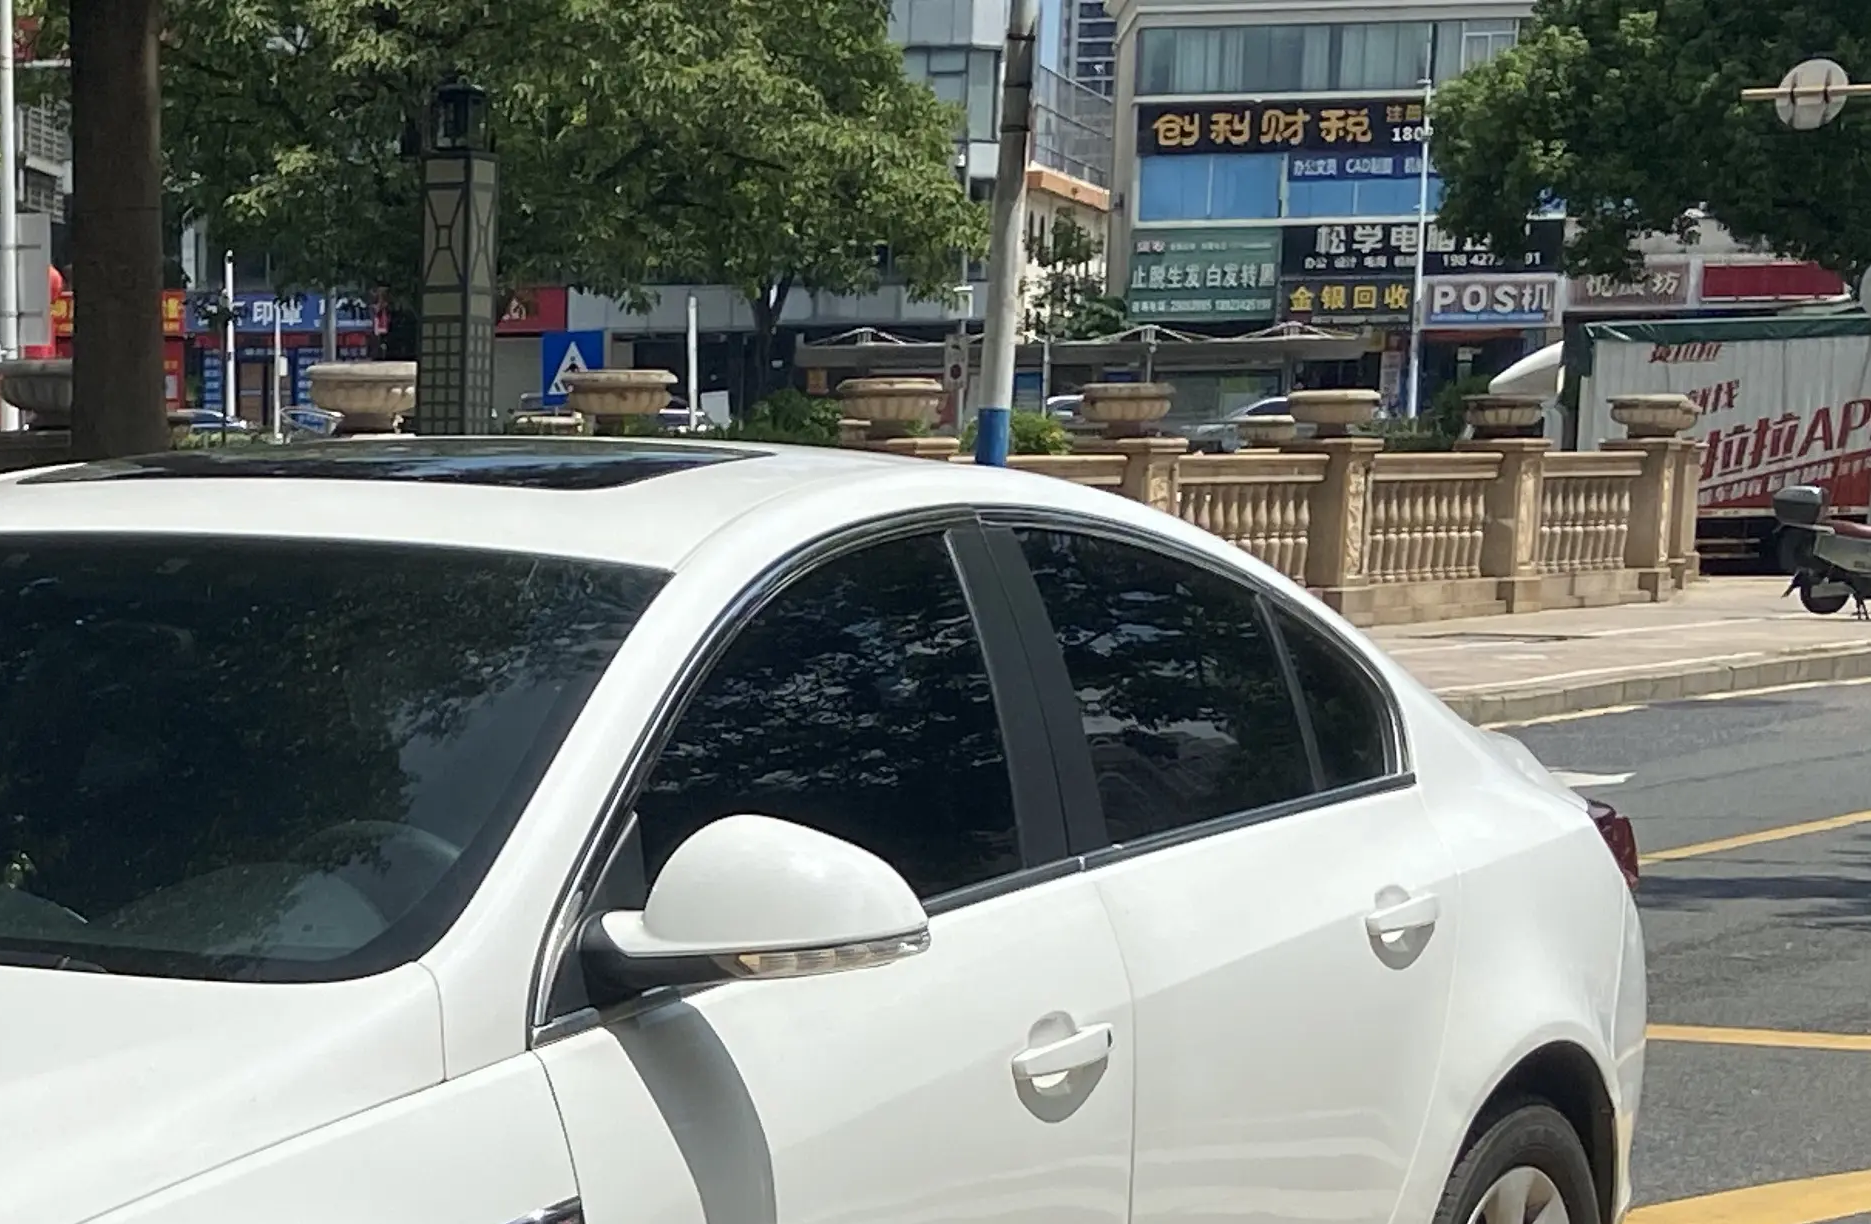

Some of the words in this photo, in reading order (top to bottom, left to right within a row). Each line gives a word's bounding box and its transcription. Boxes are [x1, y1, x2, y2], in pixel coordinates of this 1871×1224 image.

[1152, 108, 1373, 146] 创利财税
[1131, 265, 1201, 290] 止脱生发
[1289, 284, 1412, 311] 金银回收
[1432, 283, 1550, 314] POS机
[1698, 398, 1871, 482] 拉拉AP
